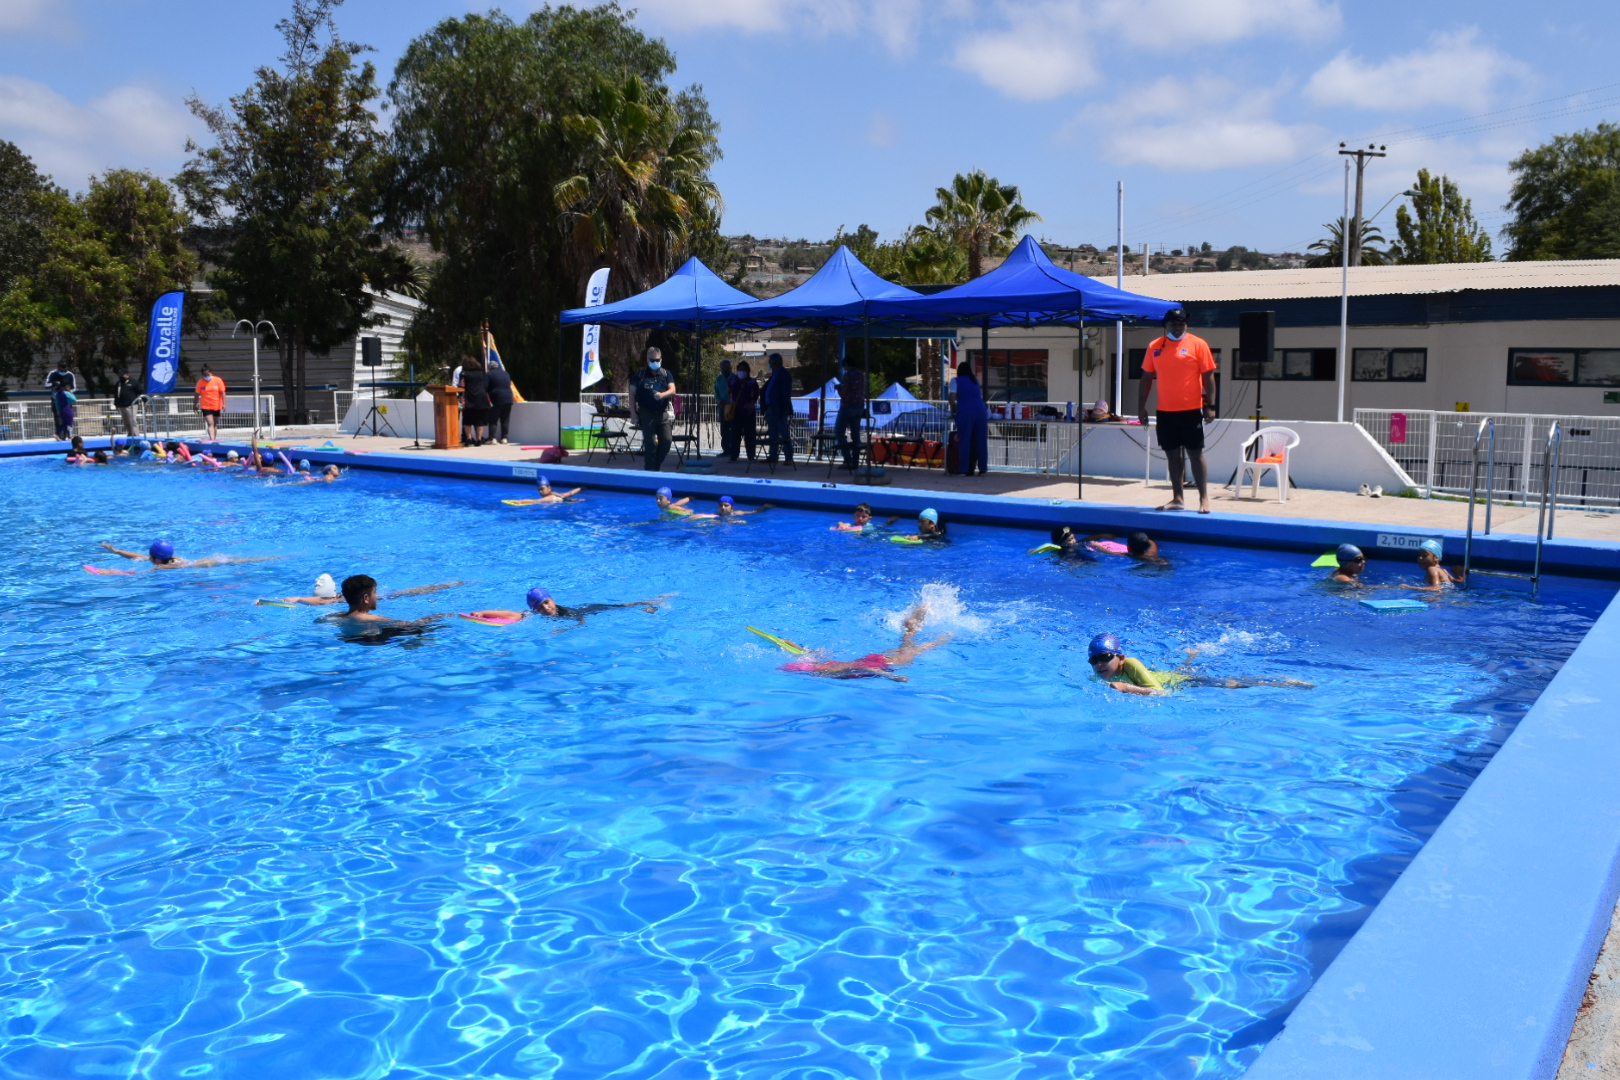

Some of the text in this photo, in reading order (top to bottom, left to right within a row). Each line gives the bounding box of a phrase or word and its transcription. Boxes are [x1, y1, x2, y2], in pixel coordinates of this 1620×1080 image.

[156, 306, 174, 358] Ovalle
[1381, 535, 1423, 548] 2,10 mt
